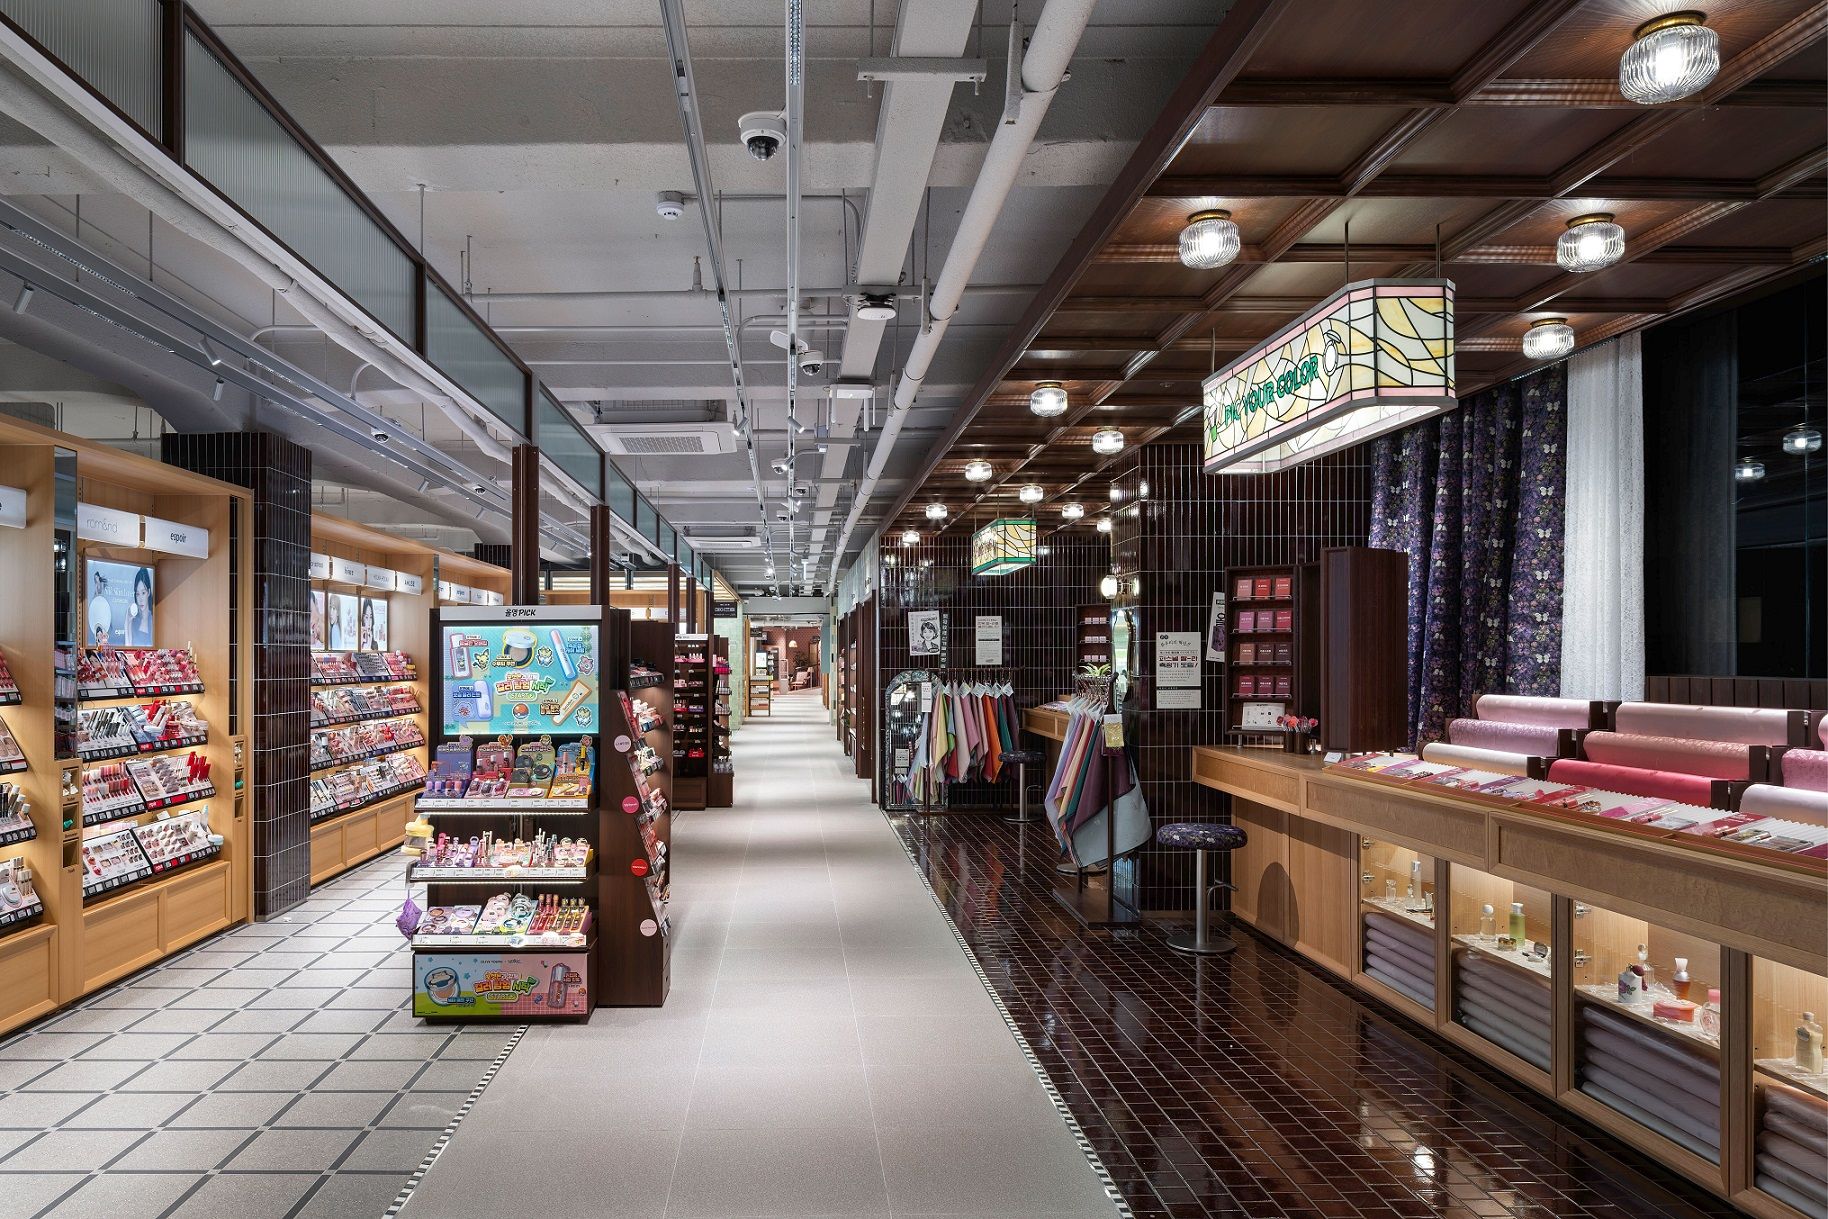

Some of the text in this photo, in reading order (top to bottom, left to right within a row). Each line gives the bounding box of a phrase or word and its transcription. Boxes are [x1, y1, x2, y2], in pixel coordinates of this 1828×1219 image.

[1243, 380, 1275, 415] YOUR
[1276, 355, 1319, 398] COLOR
[86, 518, 118, 534] rom&nd
[170, 532, 187, 544] espoir
